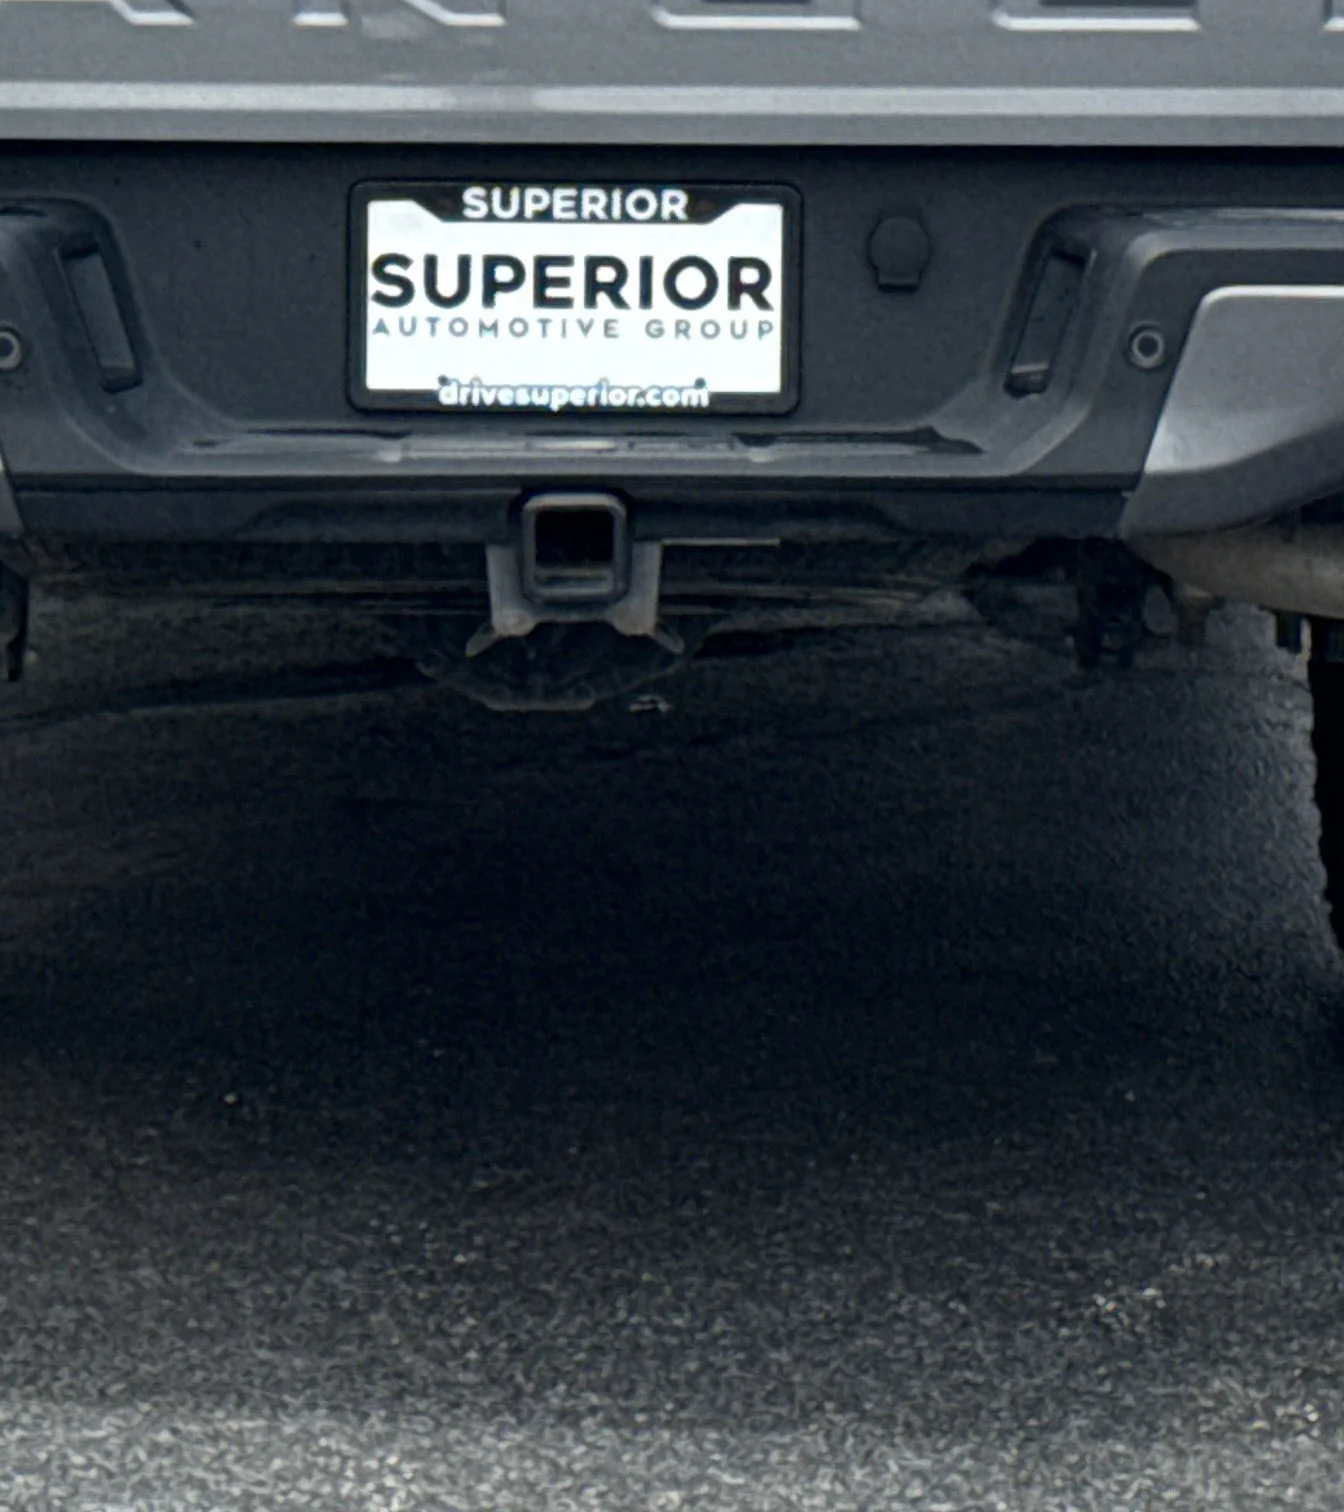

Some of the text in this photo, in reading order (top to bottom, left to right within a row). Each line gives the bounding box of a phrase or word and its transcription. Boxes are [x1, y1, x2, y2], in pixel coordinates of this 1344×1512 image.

[461, 186, 689, 221] SUPERIOR
[370, 252, 775, 312] SUPERIOR
[372, 316, 775, 341] AUTOMOTIVE GROUP
[437, 377, 711, 411] drivesuperior.com
